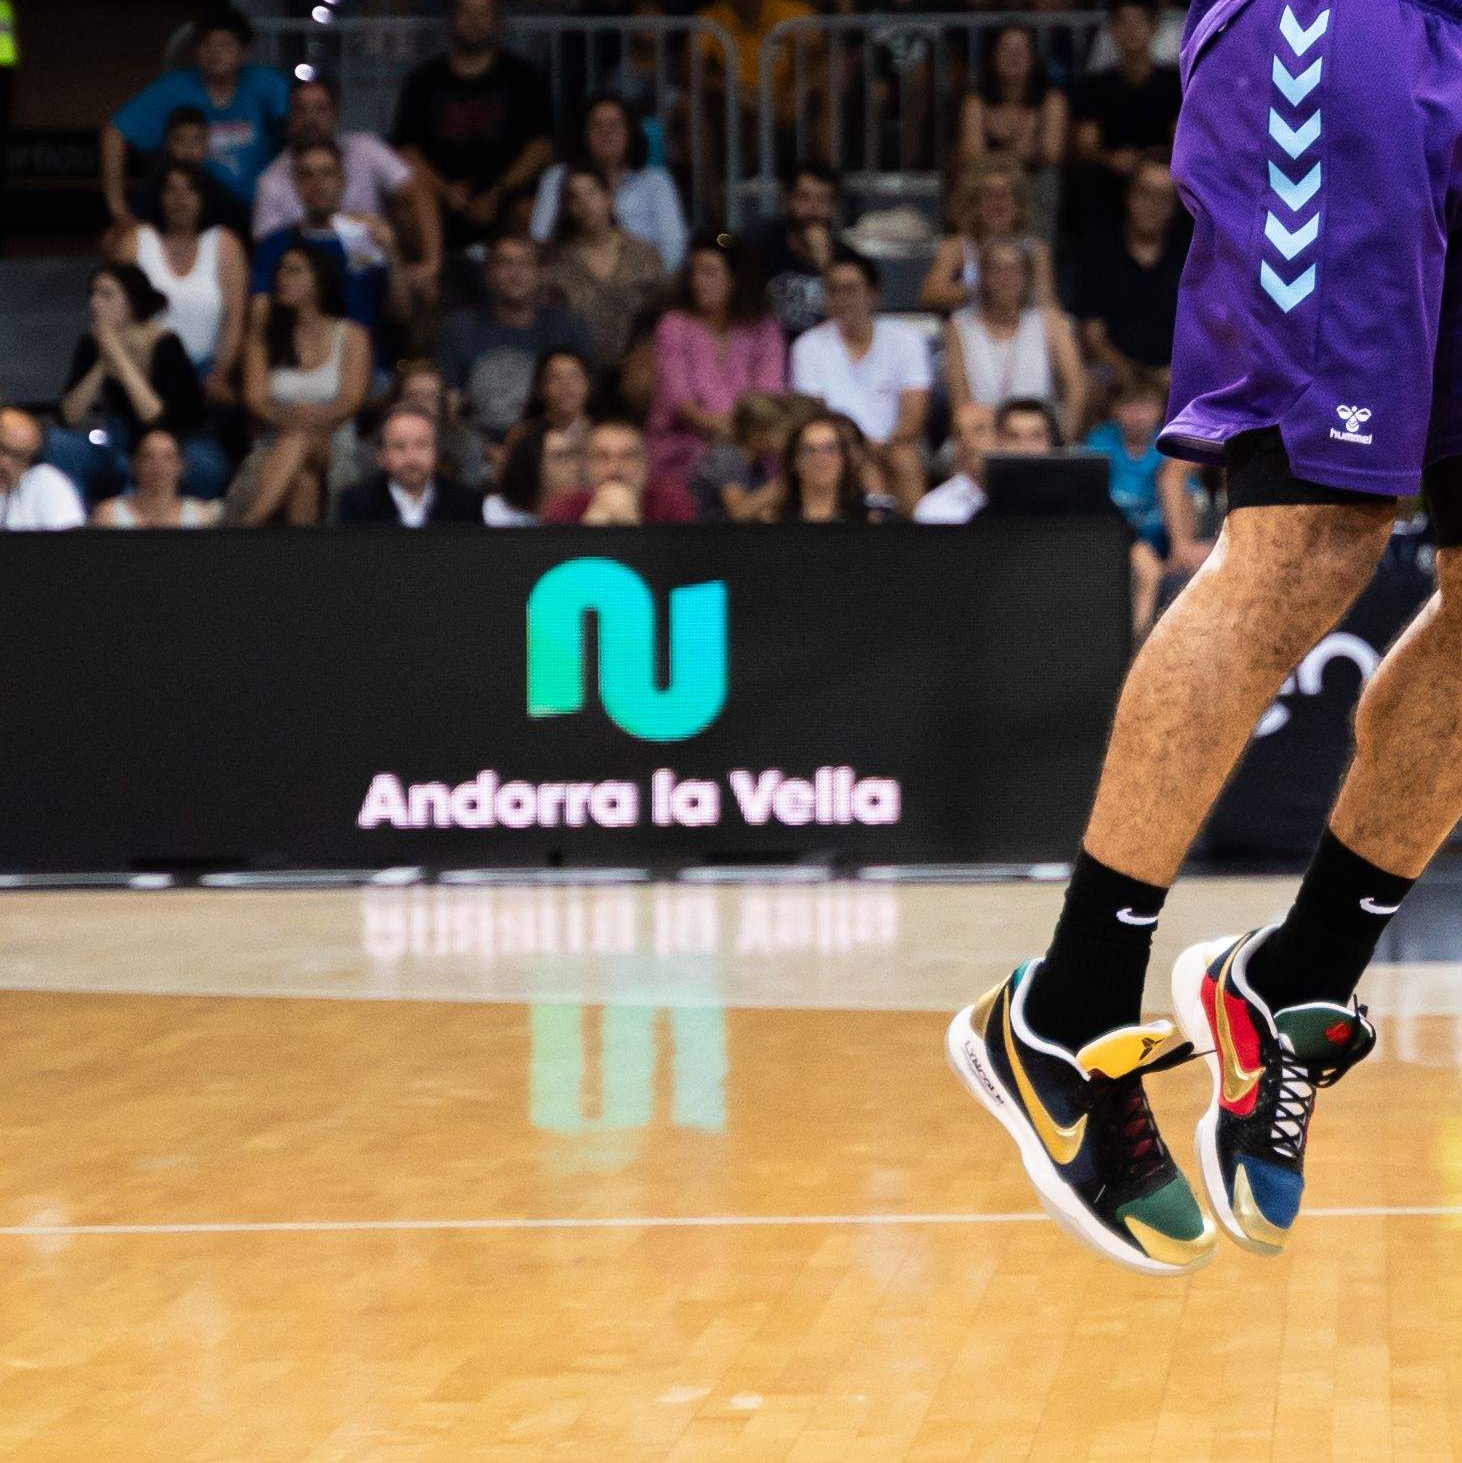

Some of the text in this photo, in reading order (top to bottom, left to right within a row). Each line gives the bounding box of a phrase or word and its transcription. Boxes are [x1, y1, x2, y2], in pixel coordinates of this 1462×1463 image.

[1329, 427, 1372, 445] hummel
[357, 766, 900, 829] Andorra la Vella
